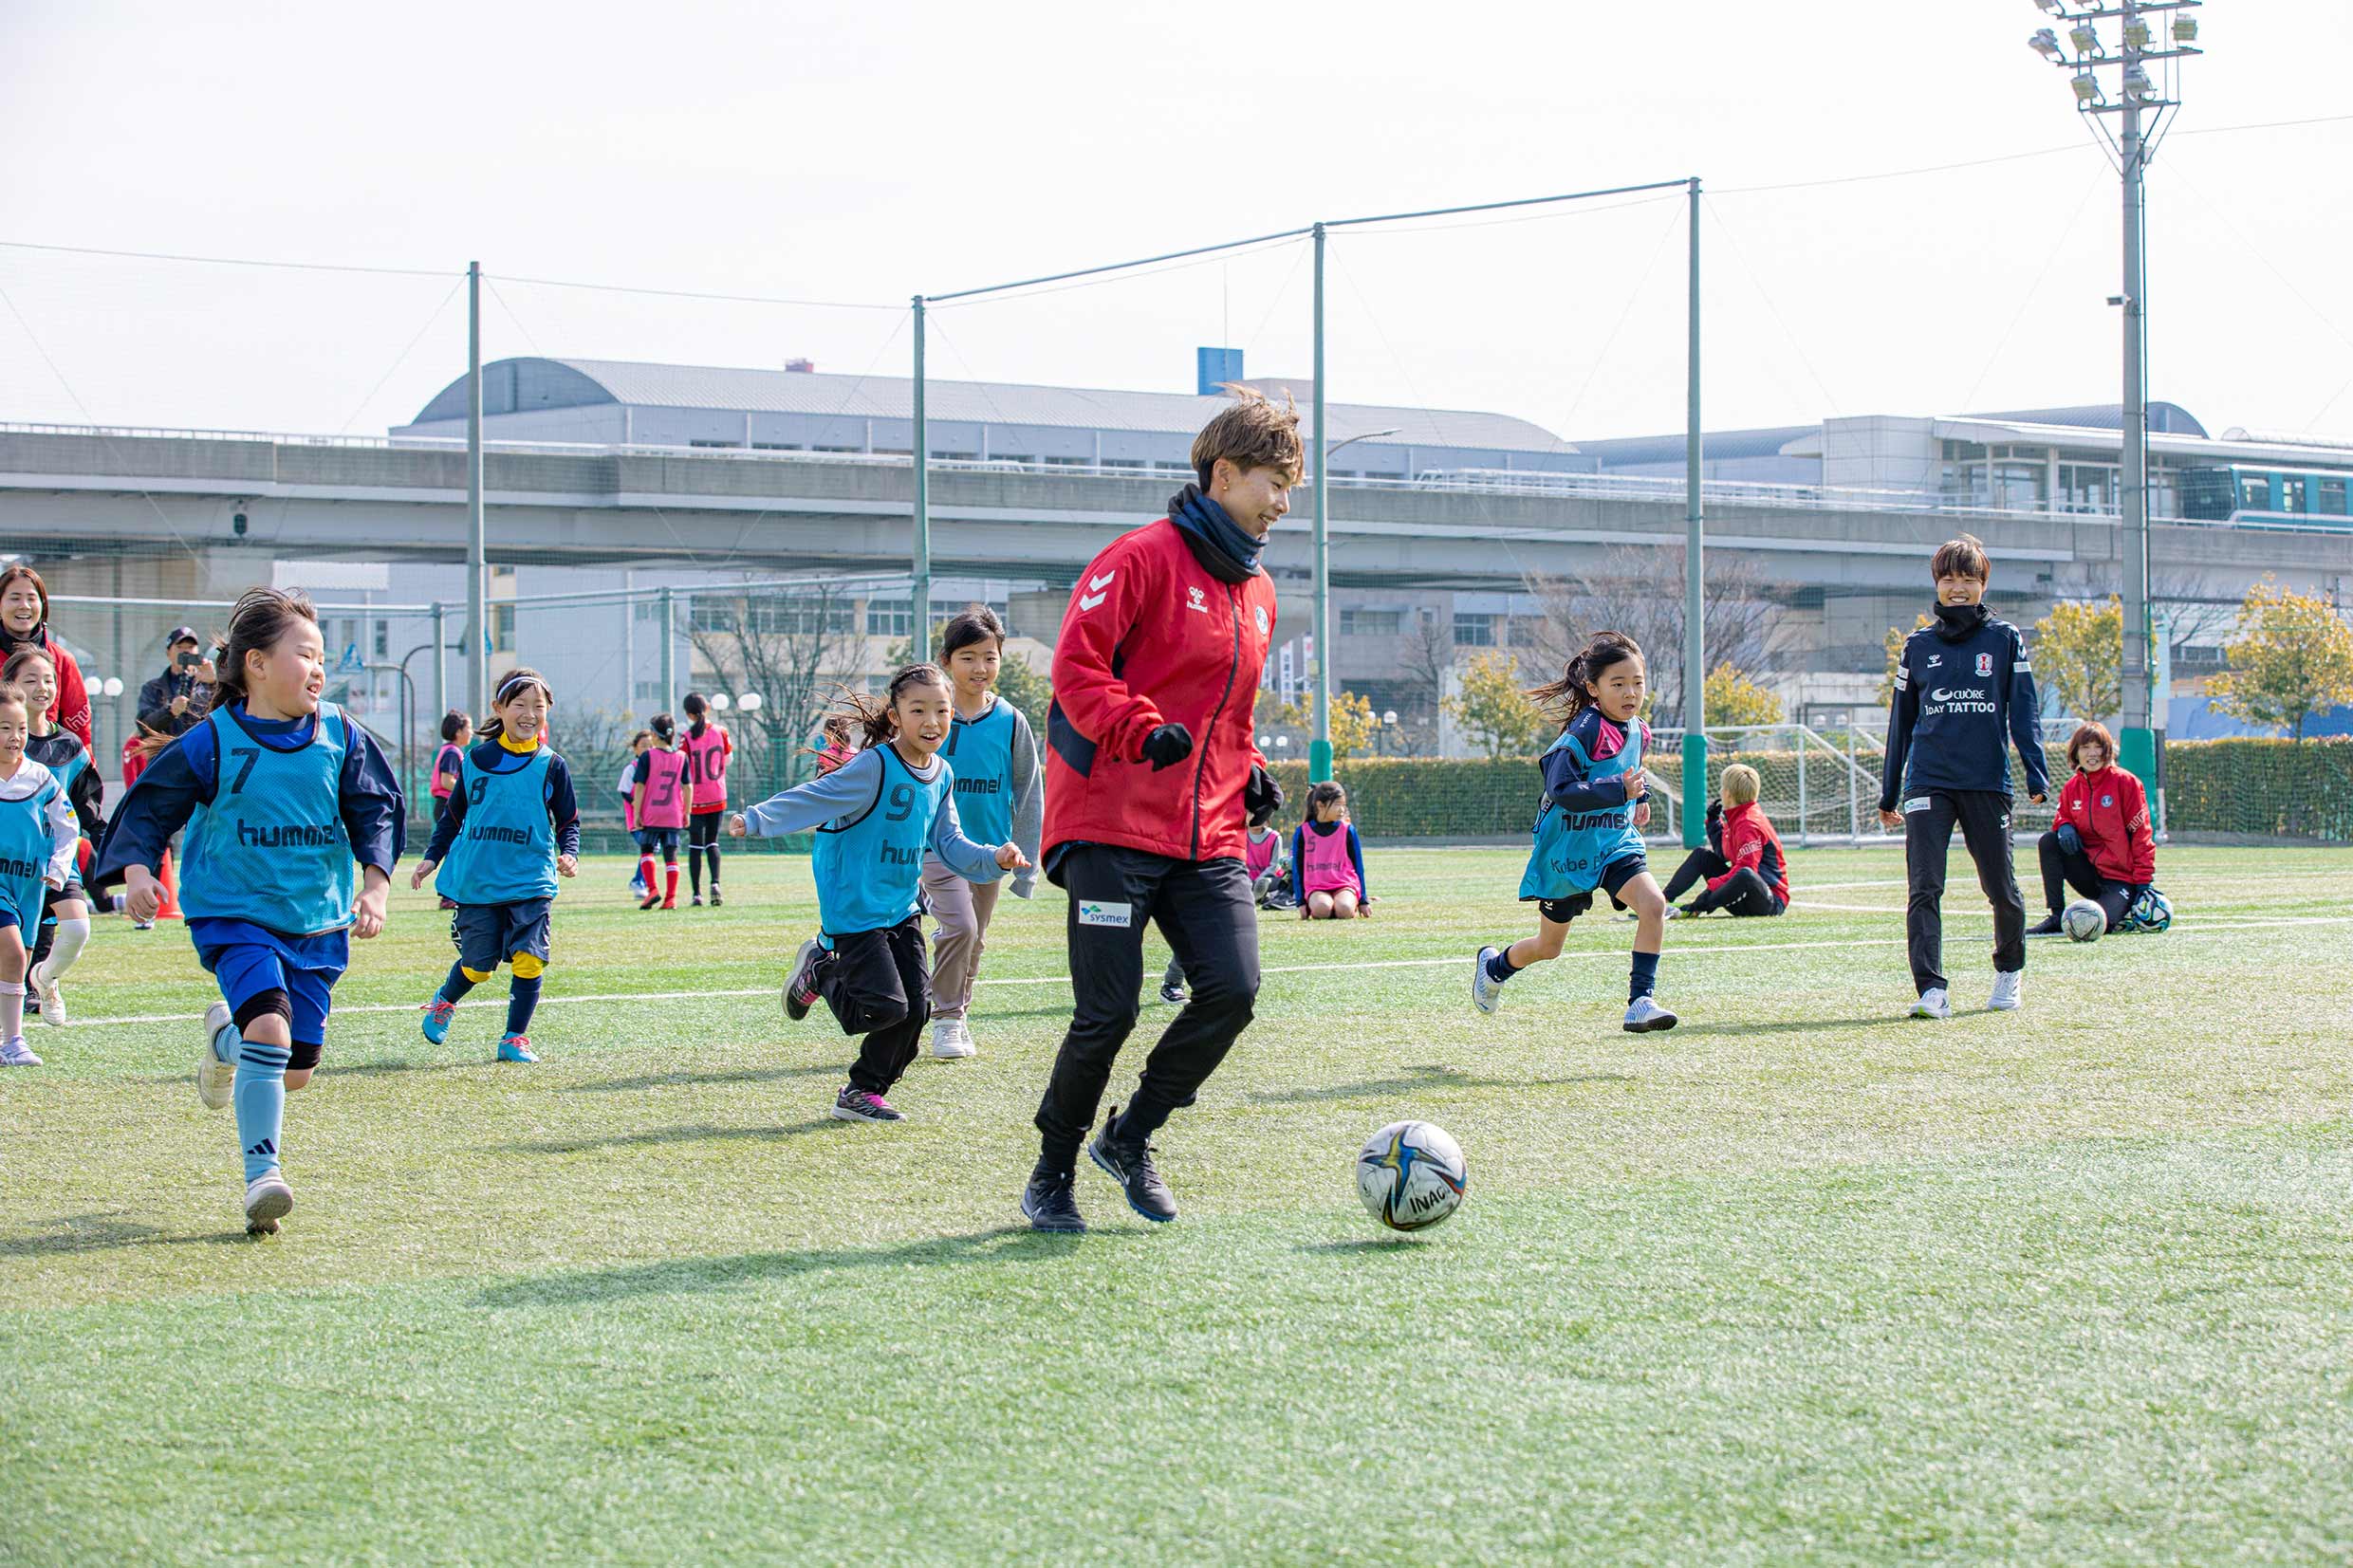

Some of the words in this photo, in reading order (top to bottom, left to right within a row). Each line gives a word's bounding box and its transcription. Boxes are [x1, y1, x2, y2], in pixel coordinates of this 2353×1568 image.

[1946, 702, 1996, 713] TATTOO
[231, 747, 261, 794] 7
[692, 745, 725, 784] 10
[469, 776, 491, 805] 8
[651, 770, 677, 806] 3
[885, 783, 916, 821] 9
[1090, 913, 1129, 924] sysmex
